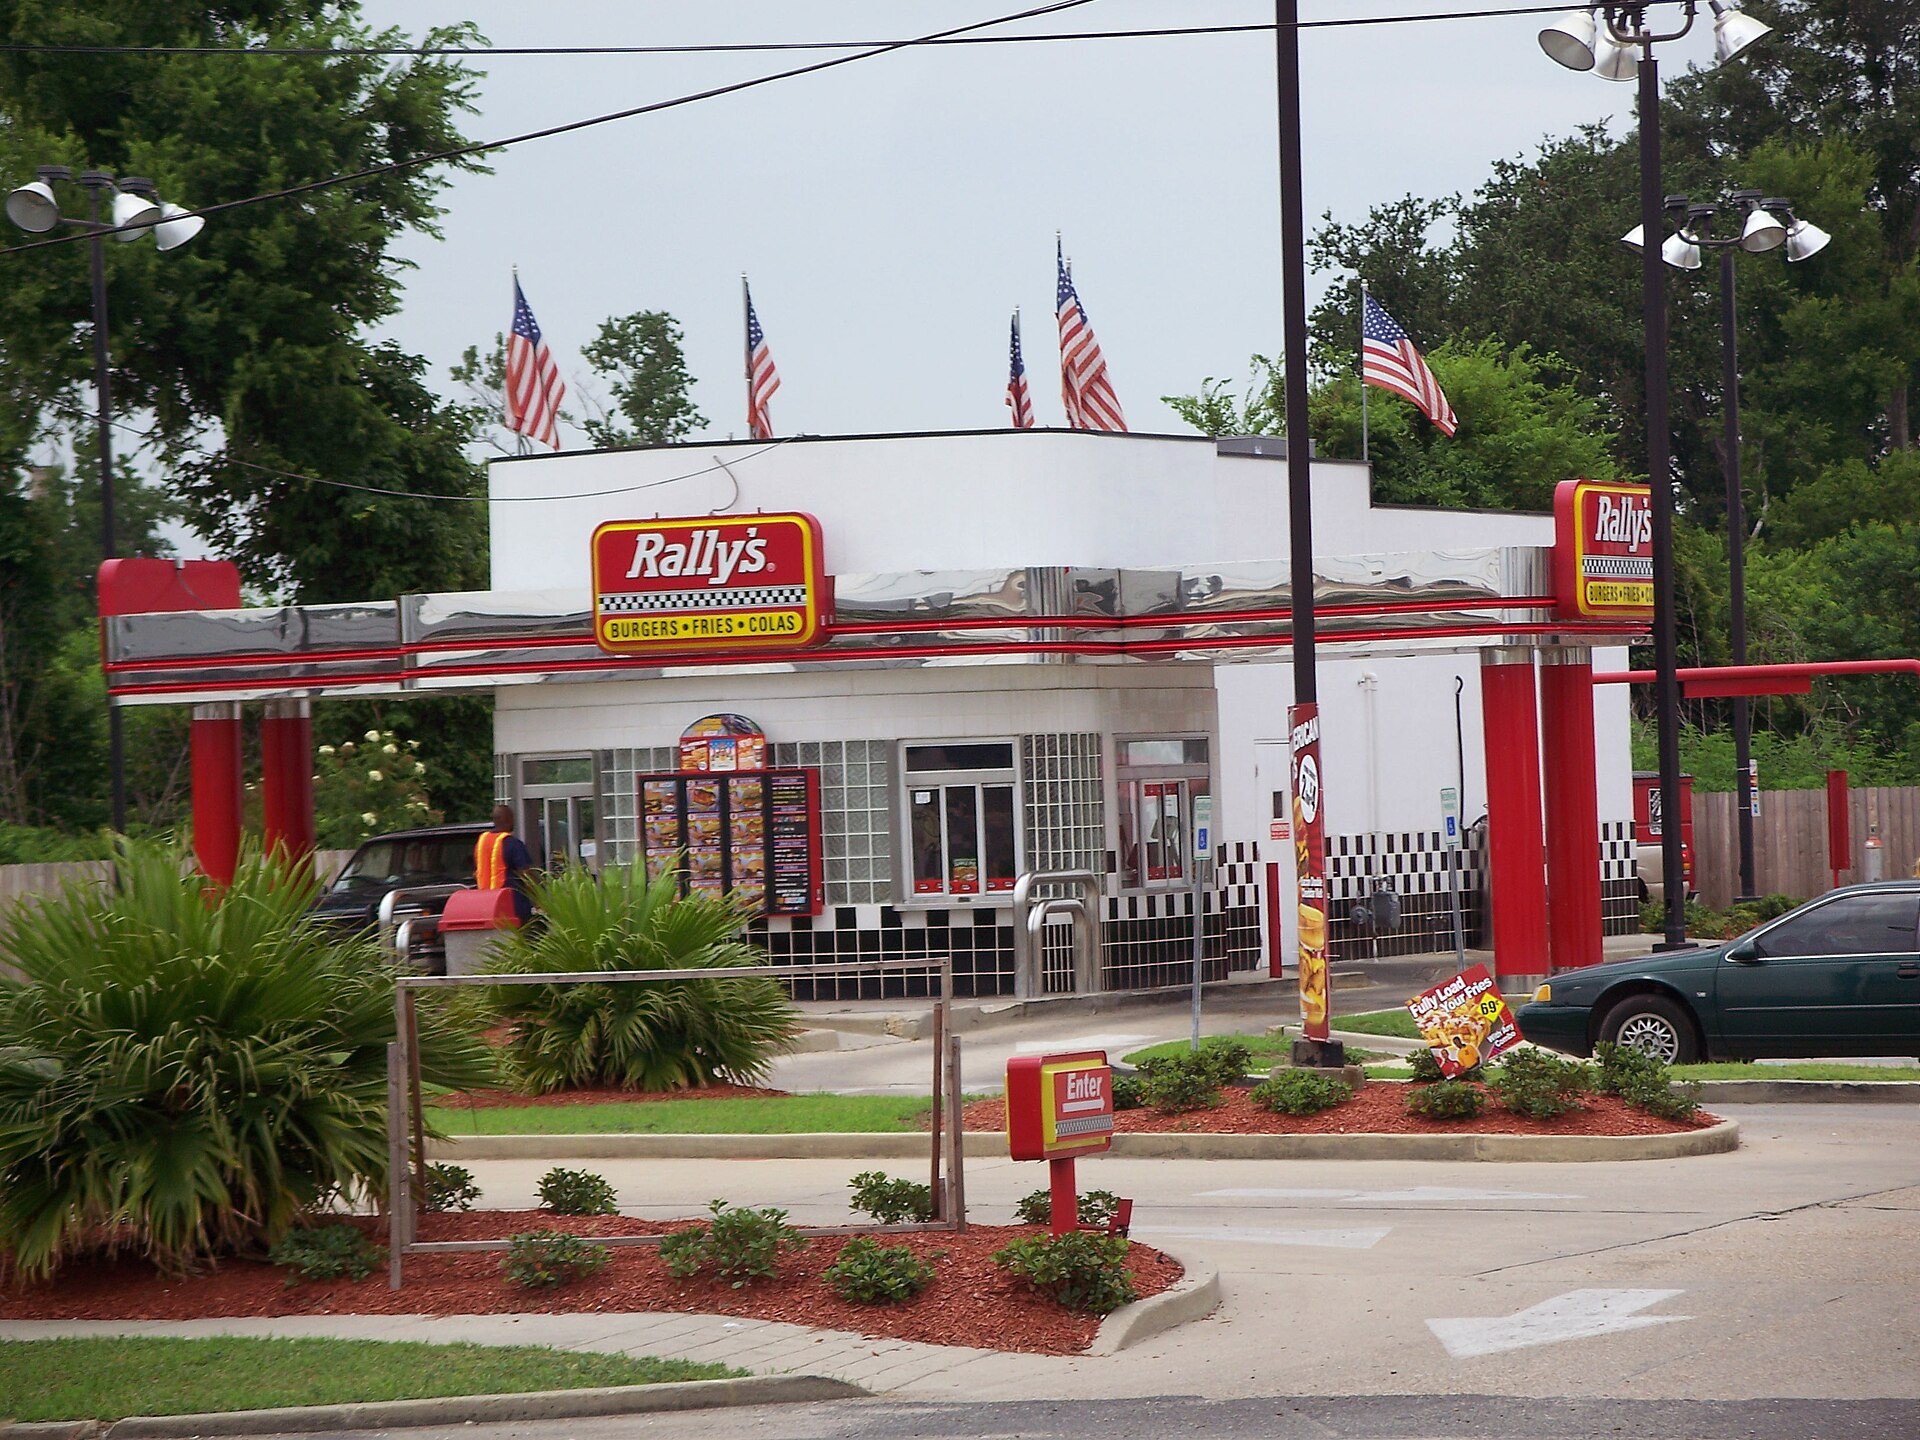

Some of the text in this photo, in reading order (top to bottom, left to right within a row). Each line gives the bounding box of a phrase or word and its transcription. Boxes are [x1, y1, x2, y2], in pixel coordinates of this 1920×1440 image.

[1595, 496, 1652, 553] Rally's
[625, 527, 768, 585] Rally's
[1590, 585, 1618, 602] BURGERS
[1623, 586, 1640, 602] FRIES
[611, 614, 795, 638] BURGERS FRIES COLAS
[1409, 976, 1467, 1018] Fully Load
[1439, 977, 1494, 1013] Your Fries
[1066, 1072, 1103, 1100] Enter
